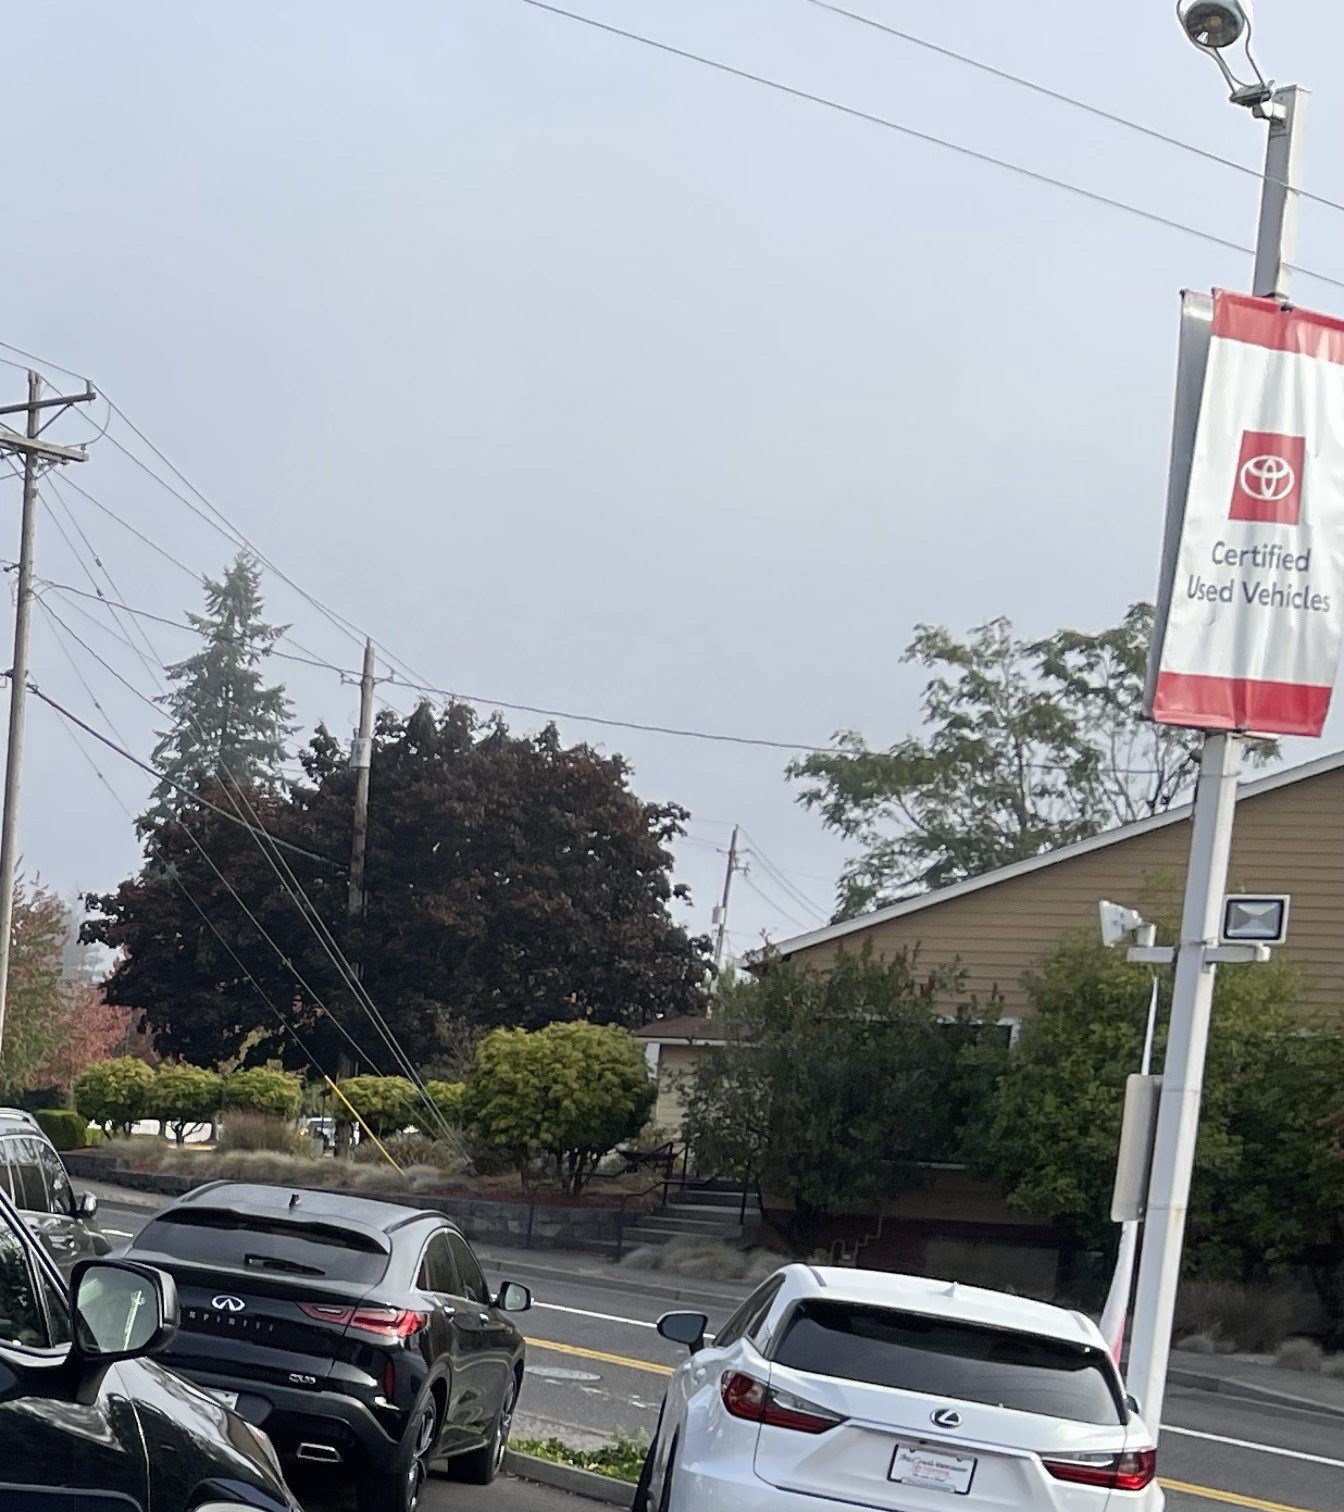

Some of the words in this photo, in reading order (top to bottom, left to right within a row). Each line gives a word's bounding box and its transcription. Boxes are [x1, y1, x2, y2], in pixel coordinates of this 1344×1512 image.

[1211, 539, 1312, 573] Certified
[1187, 573, 1235, 605] Used
[1240, 580, 1331, 613] Vehicles
